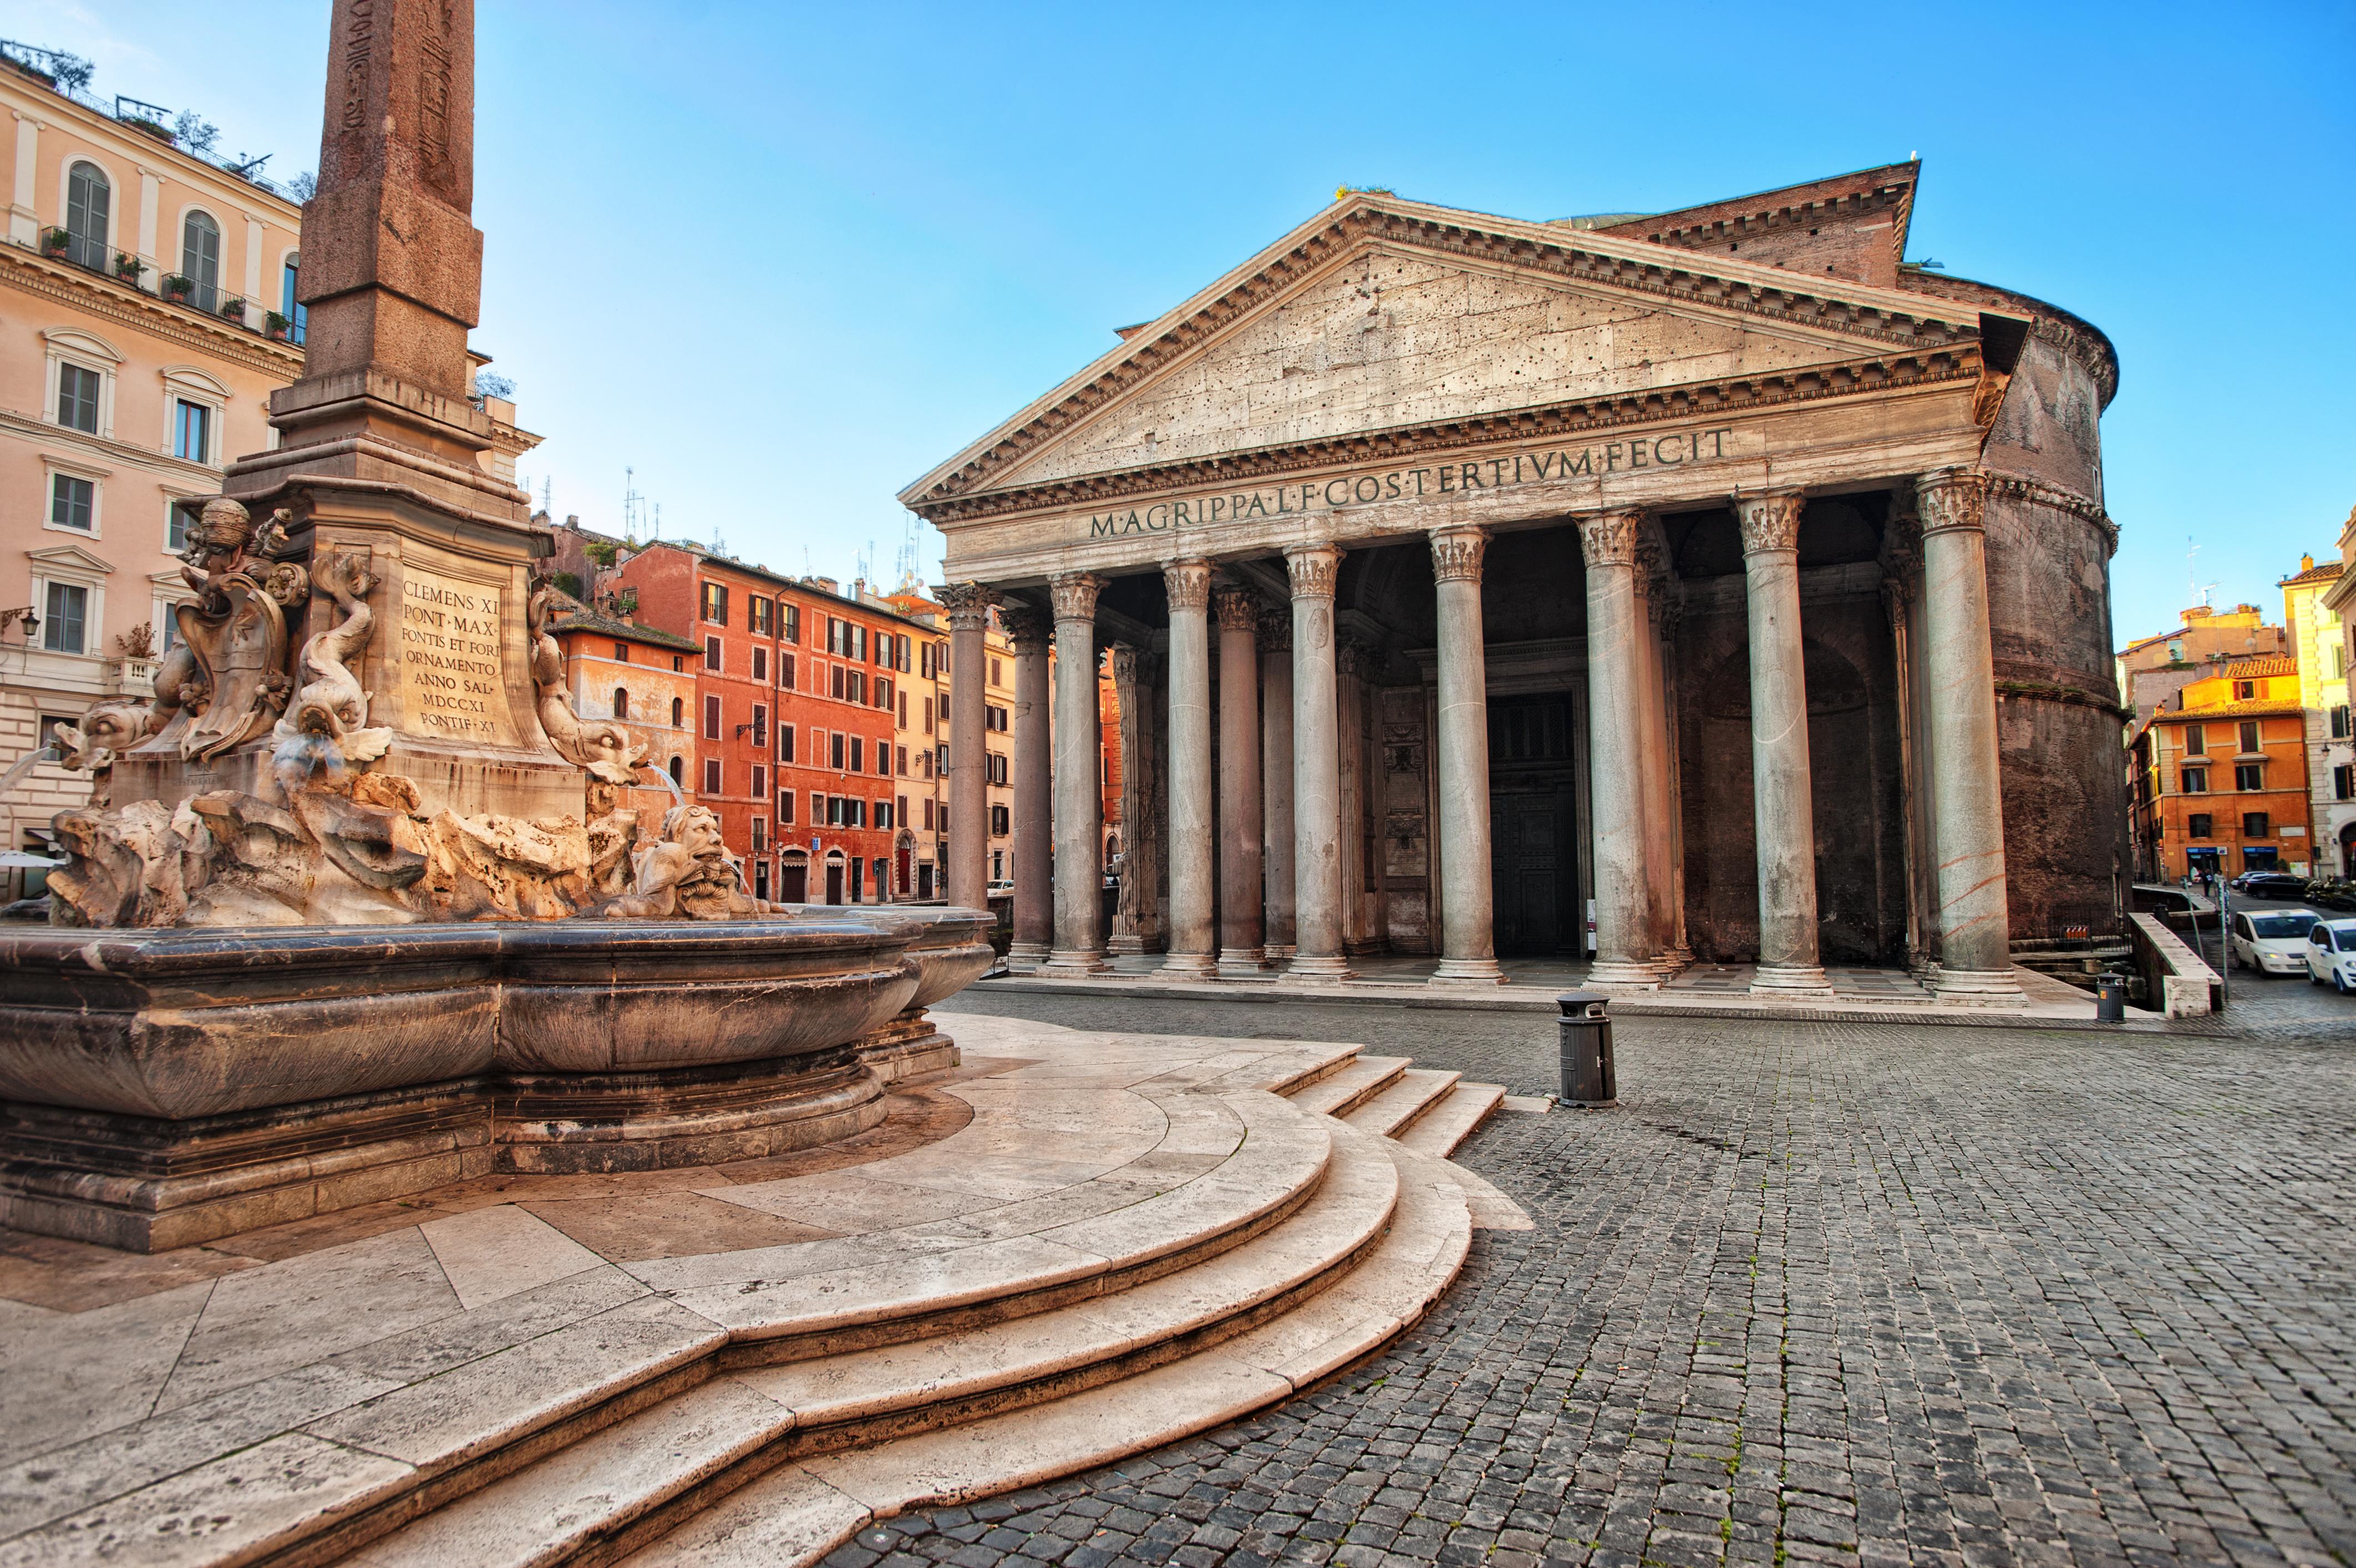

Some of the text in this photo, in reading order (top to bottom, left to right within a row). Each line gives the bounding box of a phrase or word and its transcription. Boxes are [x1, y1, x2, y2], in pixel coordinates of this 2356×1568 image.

[1605, 428, 1732, 471] FECIT
[403, 580, 499, 615] CLEMENS XI
[402, 627, 500, 657] FONTIS ET FORI
[406, 649, 495, 676] ORNAMENTO
[415, 672, 456, 689] ANNO
[423, 693, 485, 713] MDCCXI
[480, 720, 496, 733] XI
